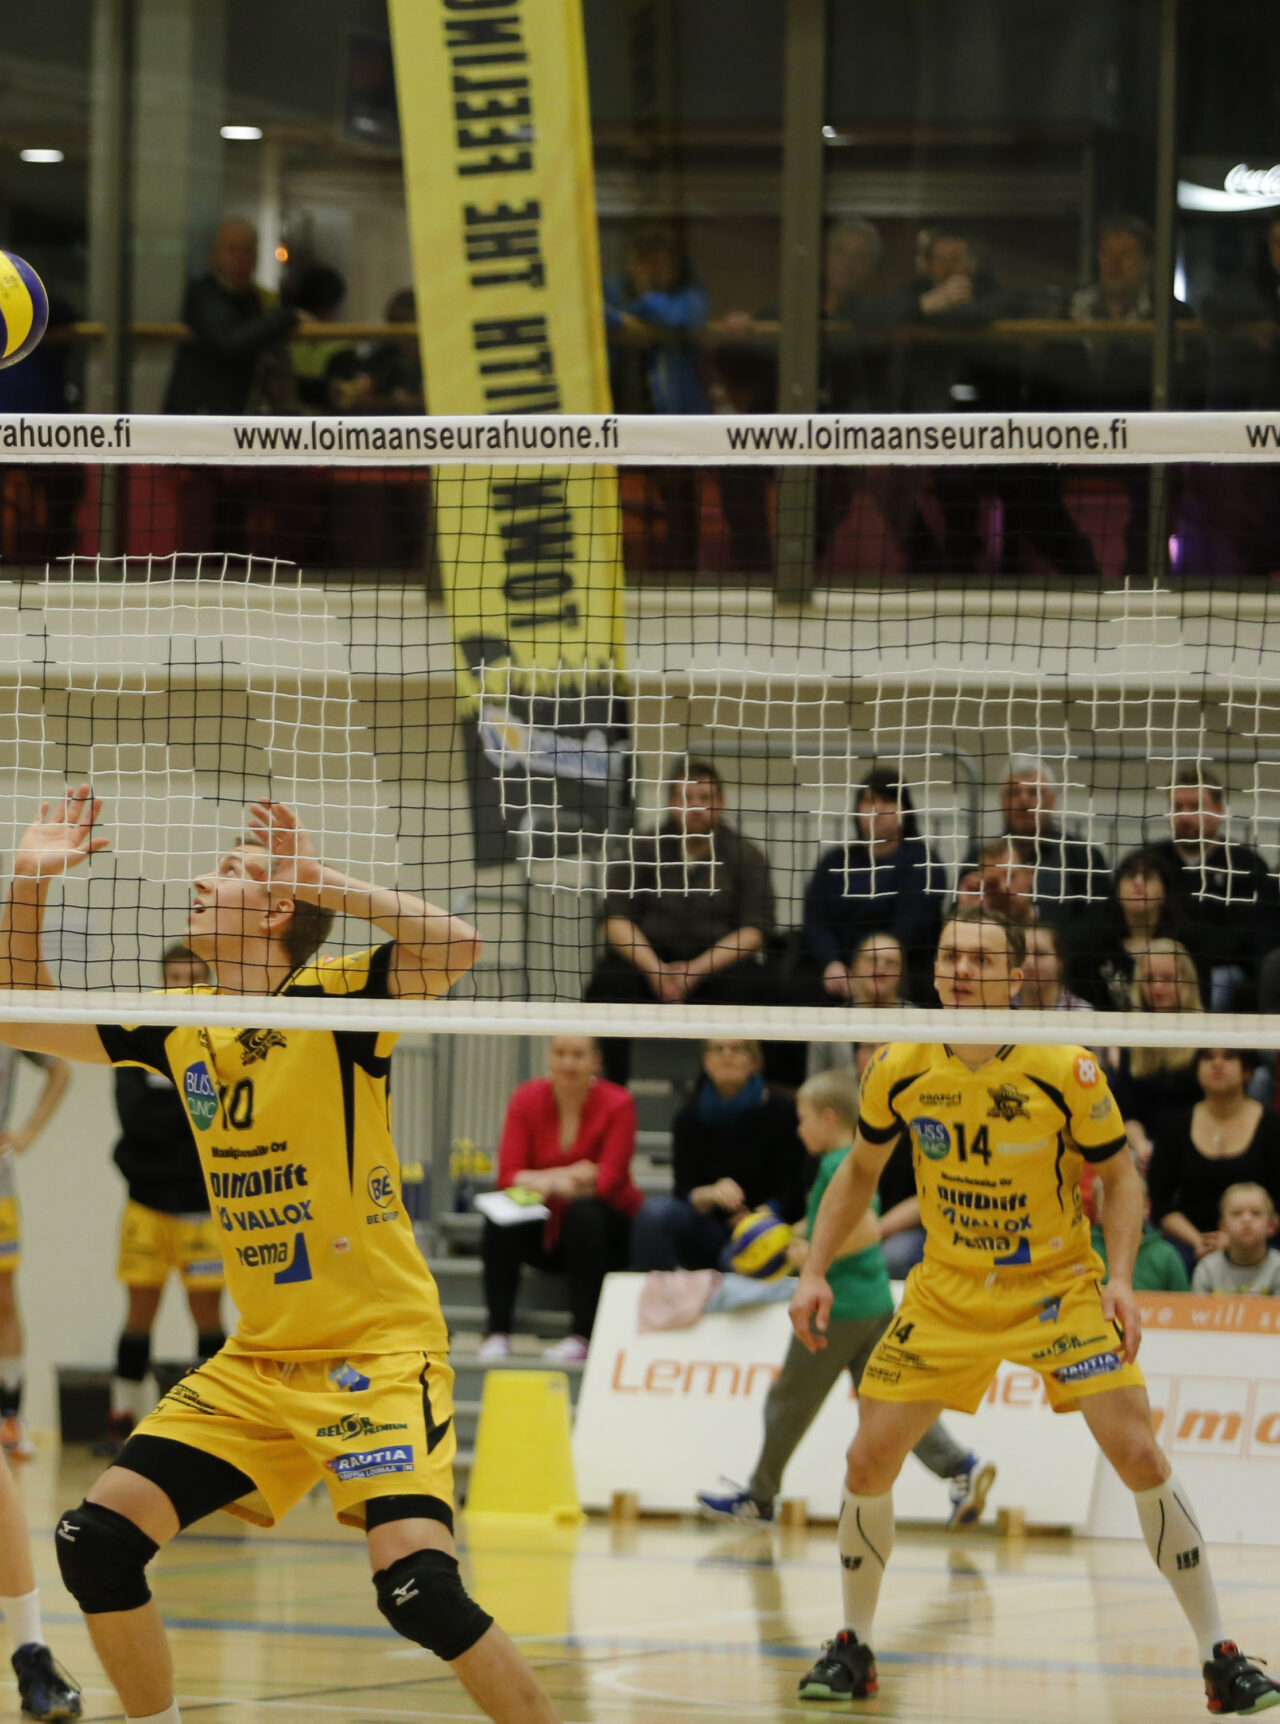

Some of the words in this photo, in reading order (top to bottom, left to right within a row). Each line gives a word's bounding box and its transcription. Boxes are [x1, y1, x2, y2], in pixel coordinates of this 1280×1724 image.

[234, 418, 619, 451] www.loimaanseurahuone.fi
[727, 418, 1129, 450] www.loimaanseurahuone.fi
[219, 1077, 255, 1132] 10
[953, 1121, 992, 1167] 14
[233, 1200, 314, 1231] VALLOX
[888, 1316, 915, 1344] 14
[1192, 1304, 1245, 1328] will
[339, 1449, 408, 1470] RAUTIA
